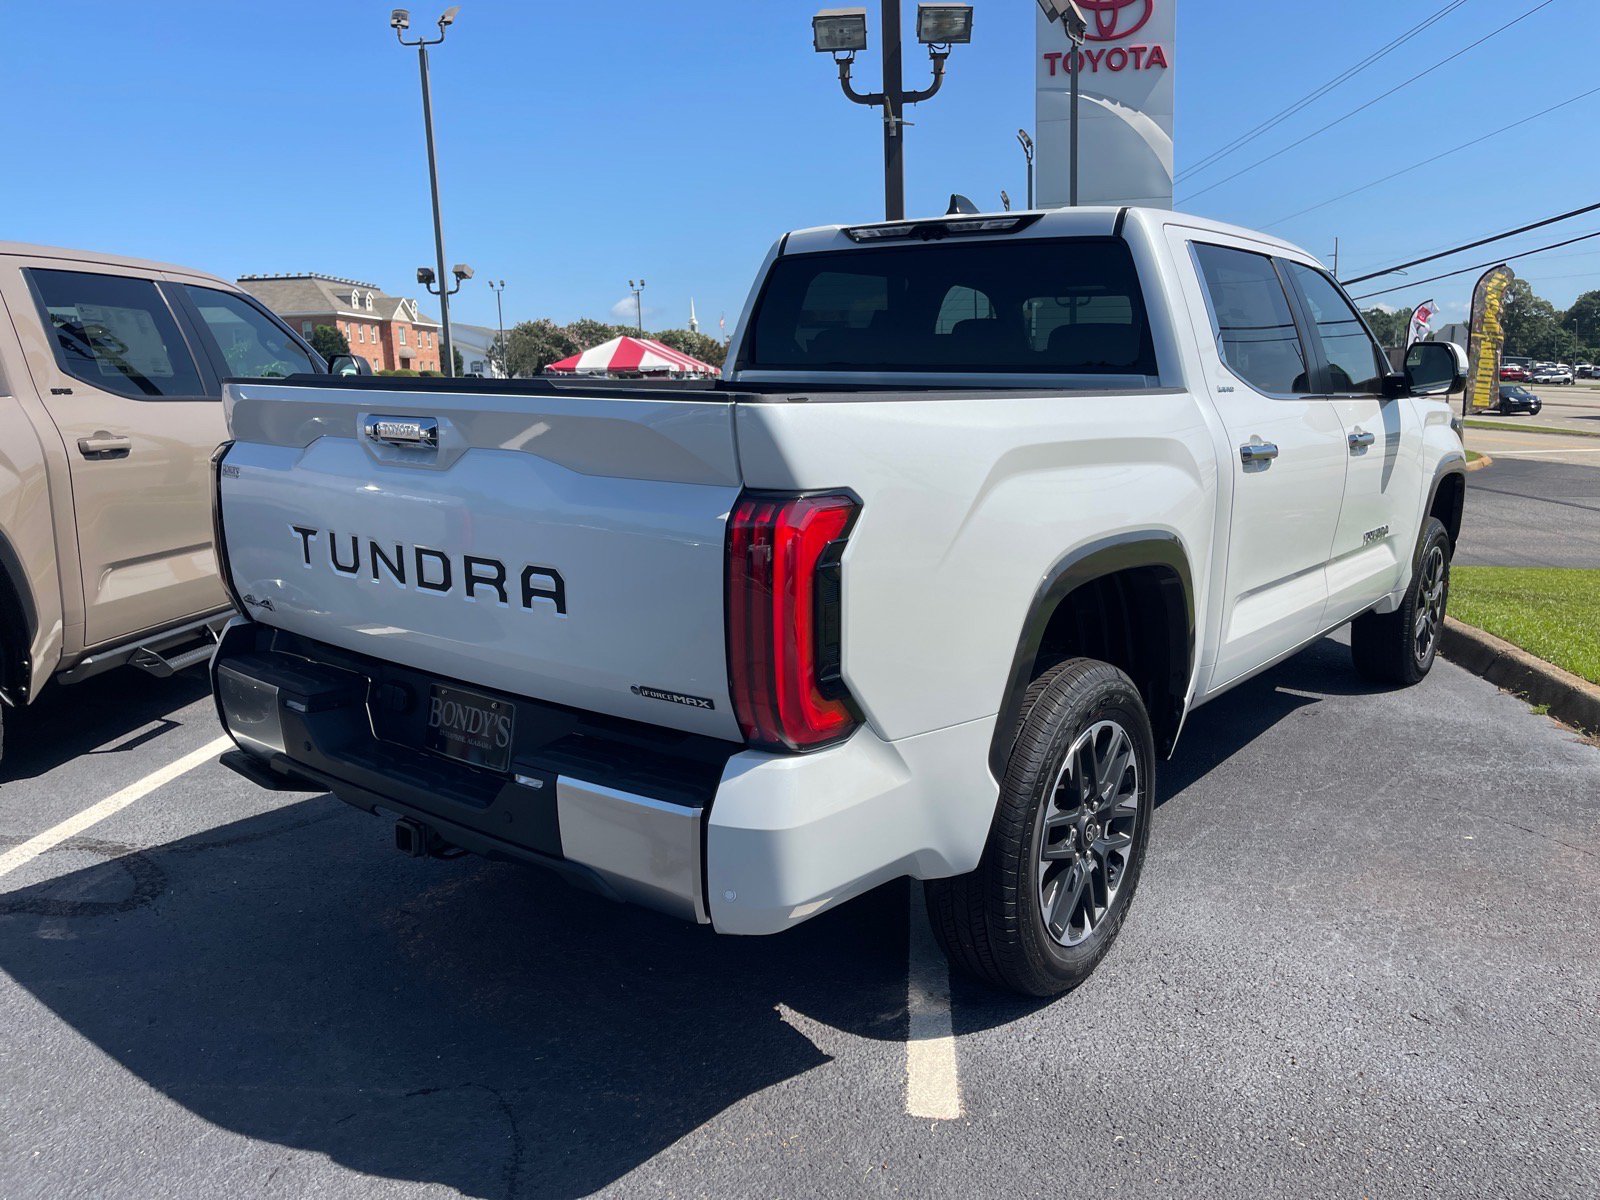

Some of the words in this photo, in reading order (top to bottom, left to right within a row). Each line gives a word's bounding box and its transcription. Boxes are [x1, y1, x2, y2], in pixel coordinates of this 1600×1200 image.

[1043, 45, 1168, 76] TOYOTA
[1472, 340, 1497, 407] MILITARY
[290, 524, 568, 618] TUNDRA
[428, 696, 511, 748] BONDY'S
